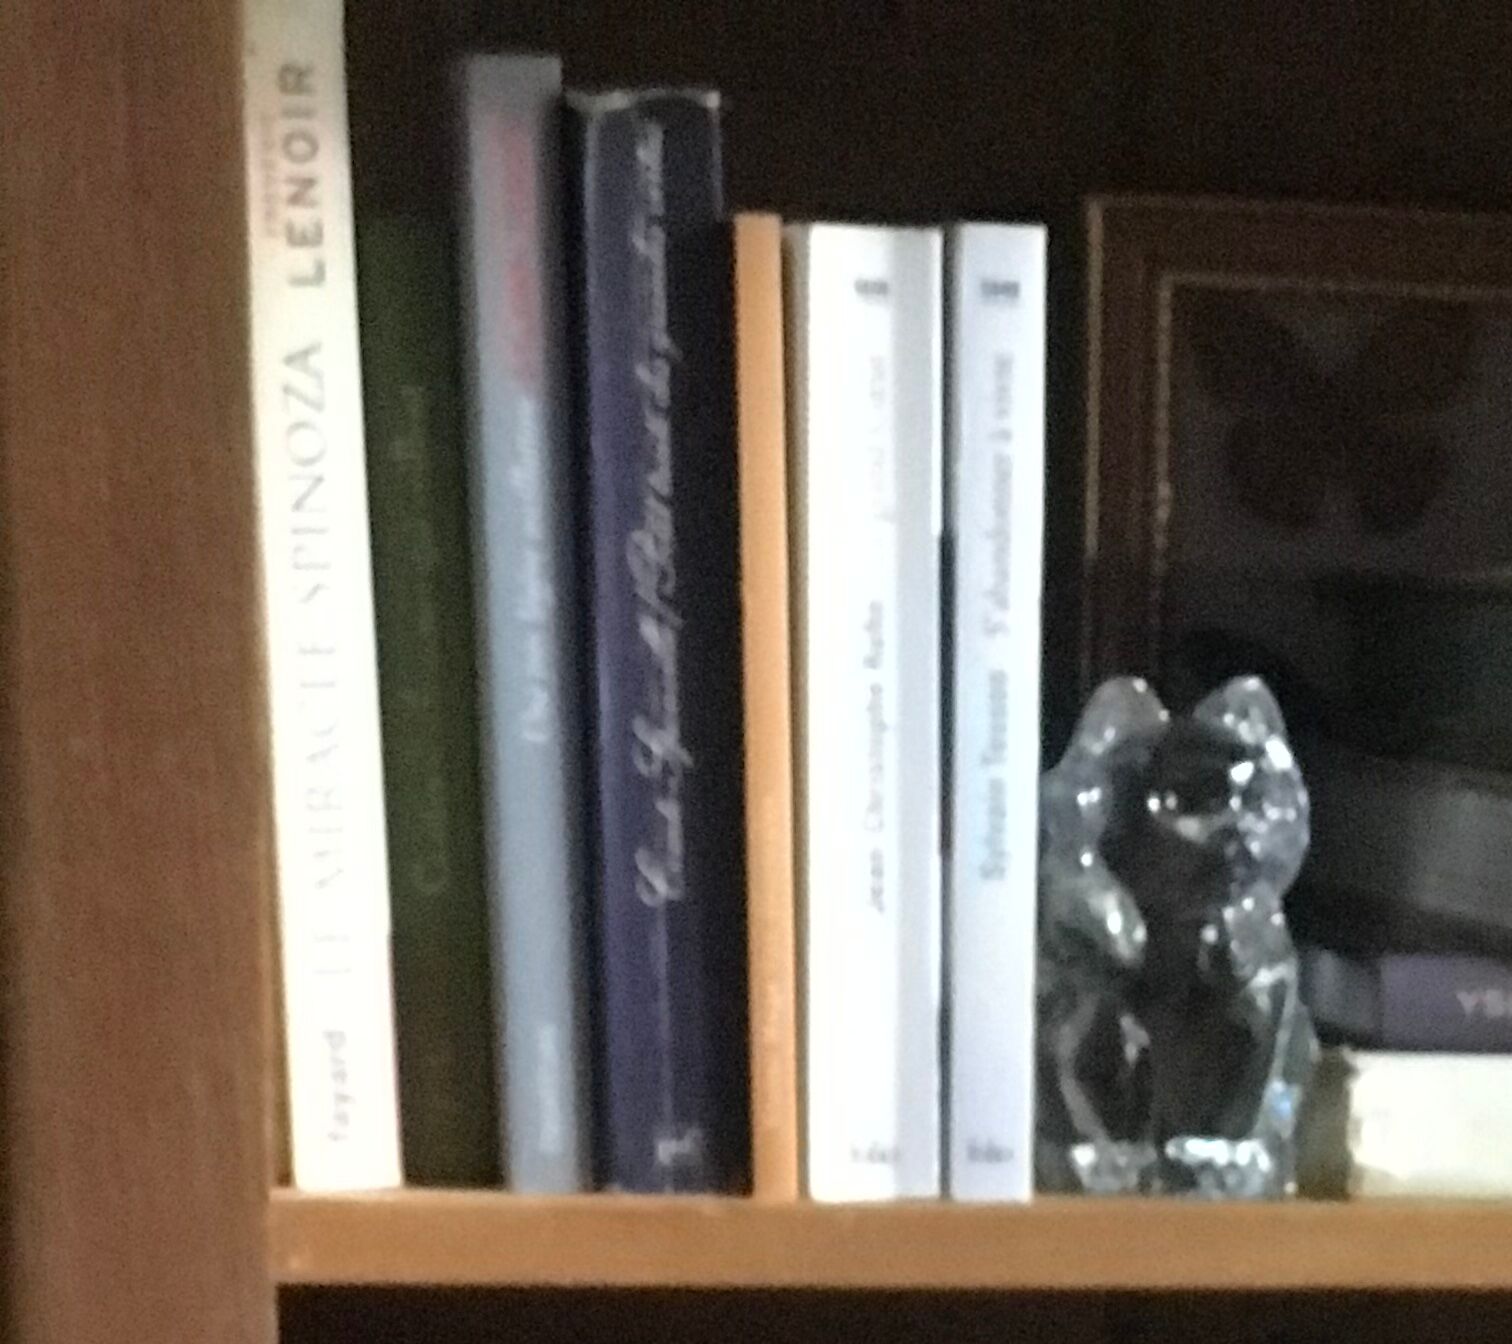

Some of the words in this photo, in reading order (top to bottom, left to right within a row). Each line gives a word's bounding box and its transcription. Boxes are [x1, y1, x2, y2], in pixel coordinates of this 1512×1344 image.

[278, 60, 327, 288] LENOIR
[282, 339, 331, 604] SPINOZA
[298, 634, 350, 891] MIRACLE
[322, 1028, 355, 1142] fayard
